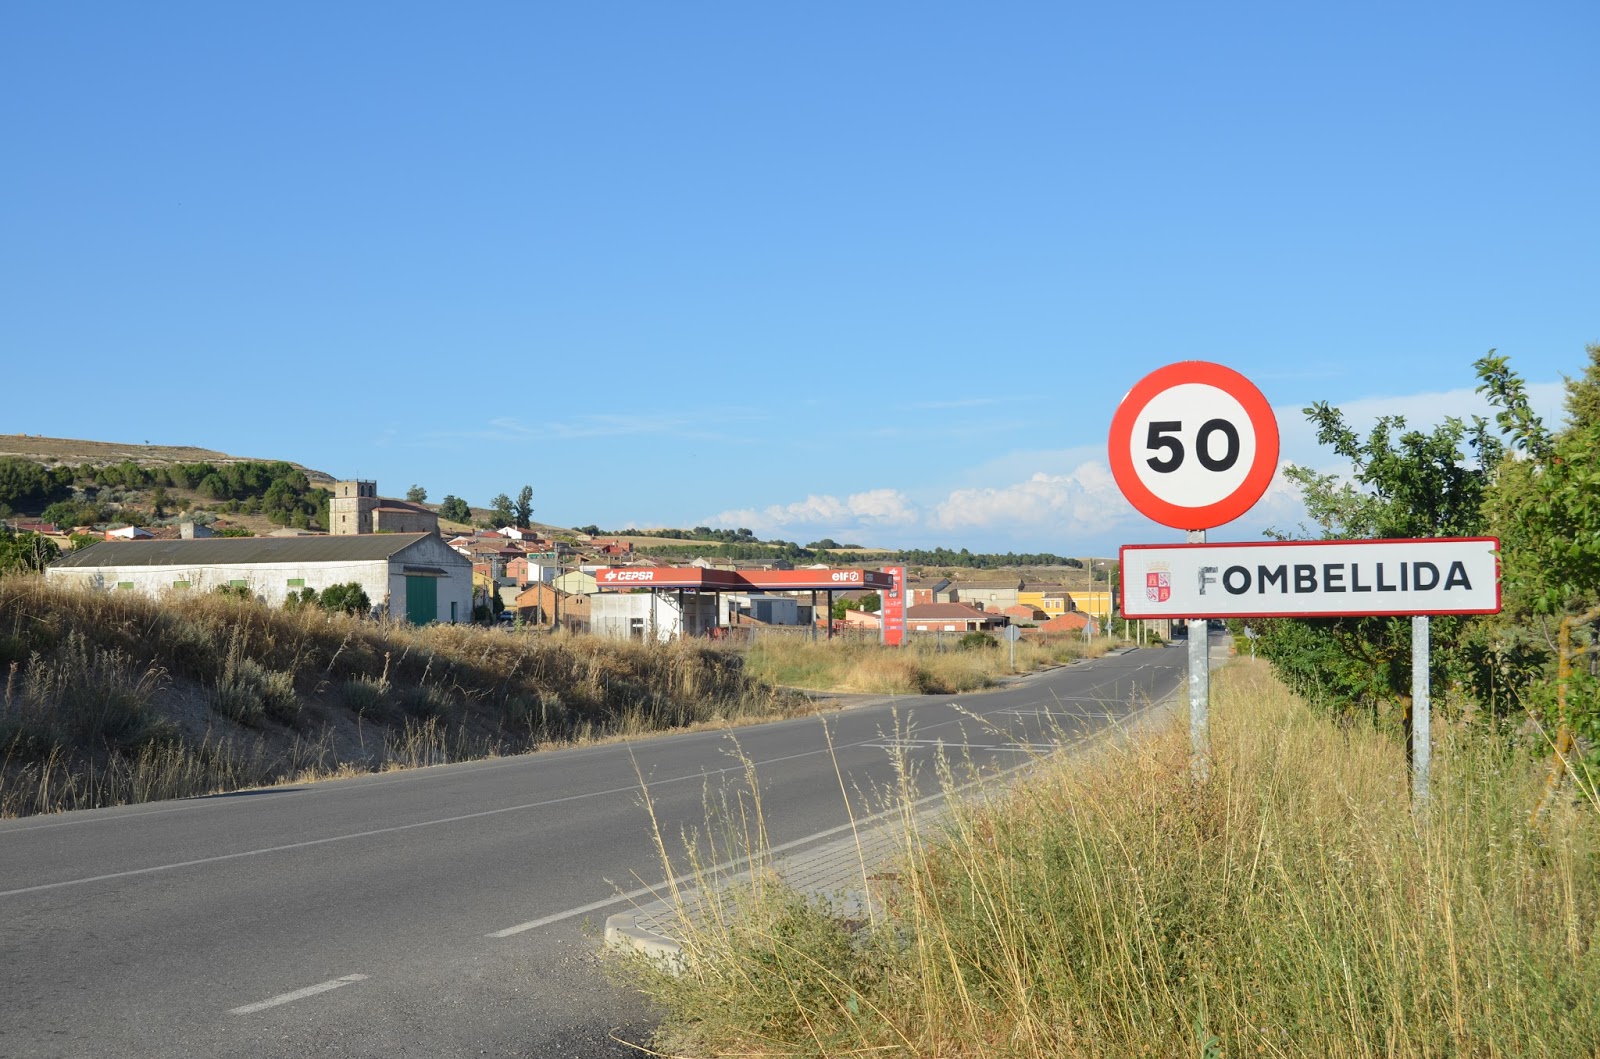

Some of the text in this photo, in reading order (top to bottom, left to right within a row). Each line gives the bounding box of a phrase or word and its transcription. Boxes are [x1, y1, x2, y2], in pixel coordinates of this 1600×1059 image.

[1146, 418, 1240, 474] 50
[617, 571, 654, 581] CEPSA
[831, 572, 849, 581] elf
[1199, 560, 1472, 596] FOMBELLIDA
